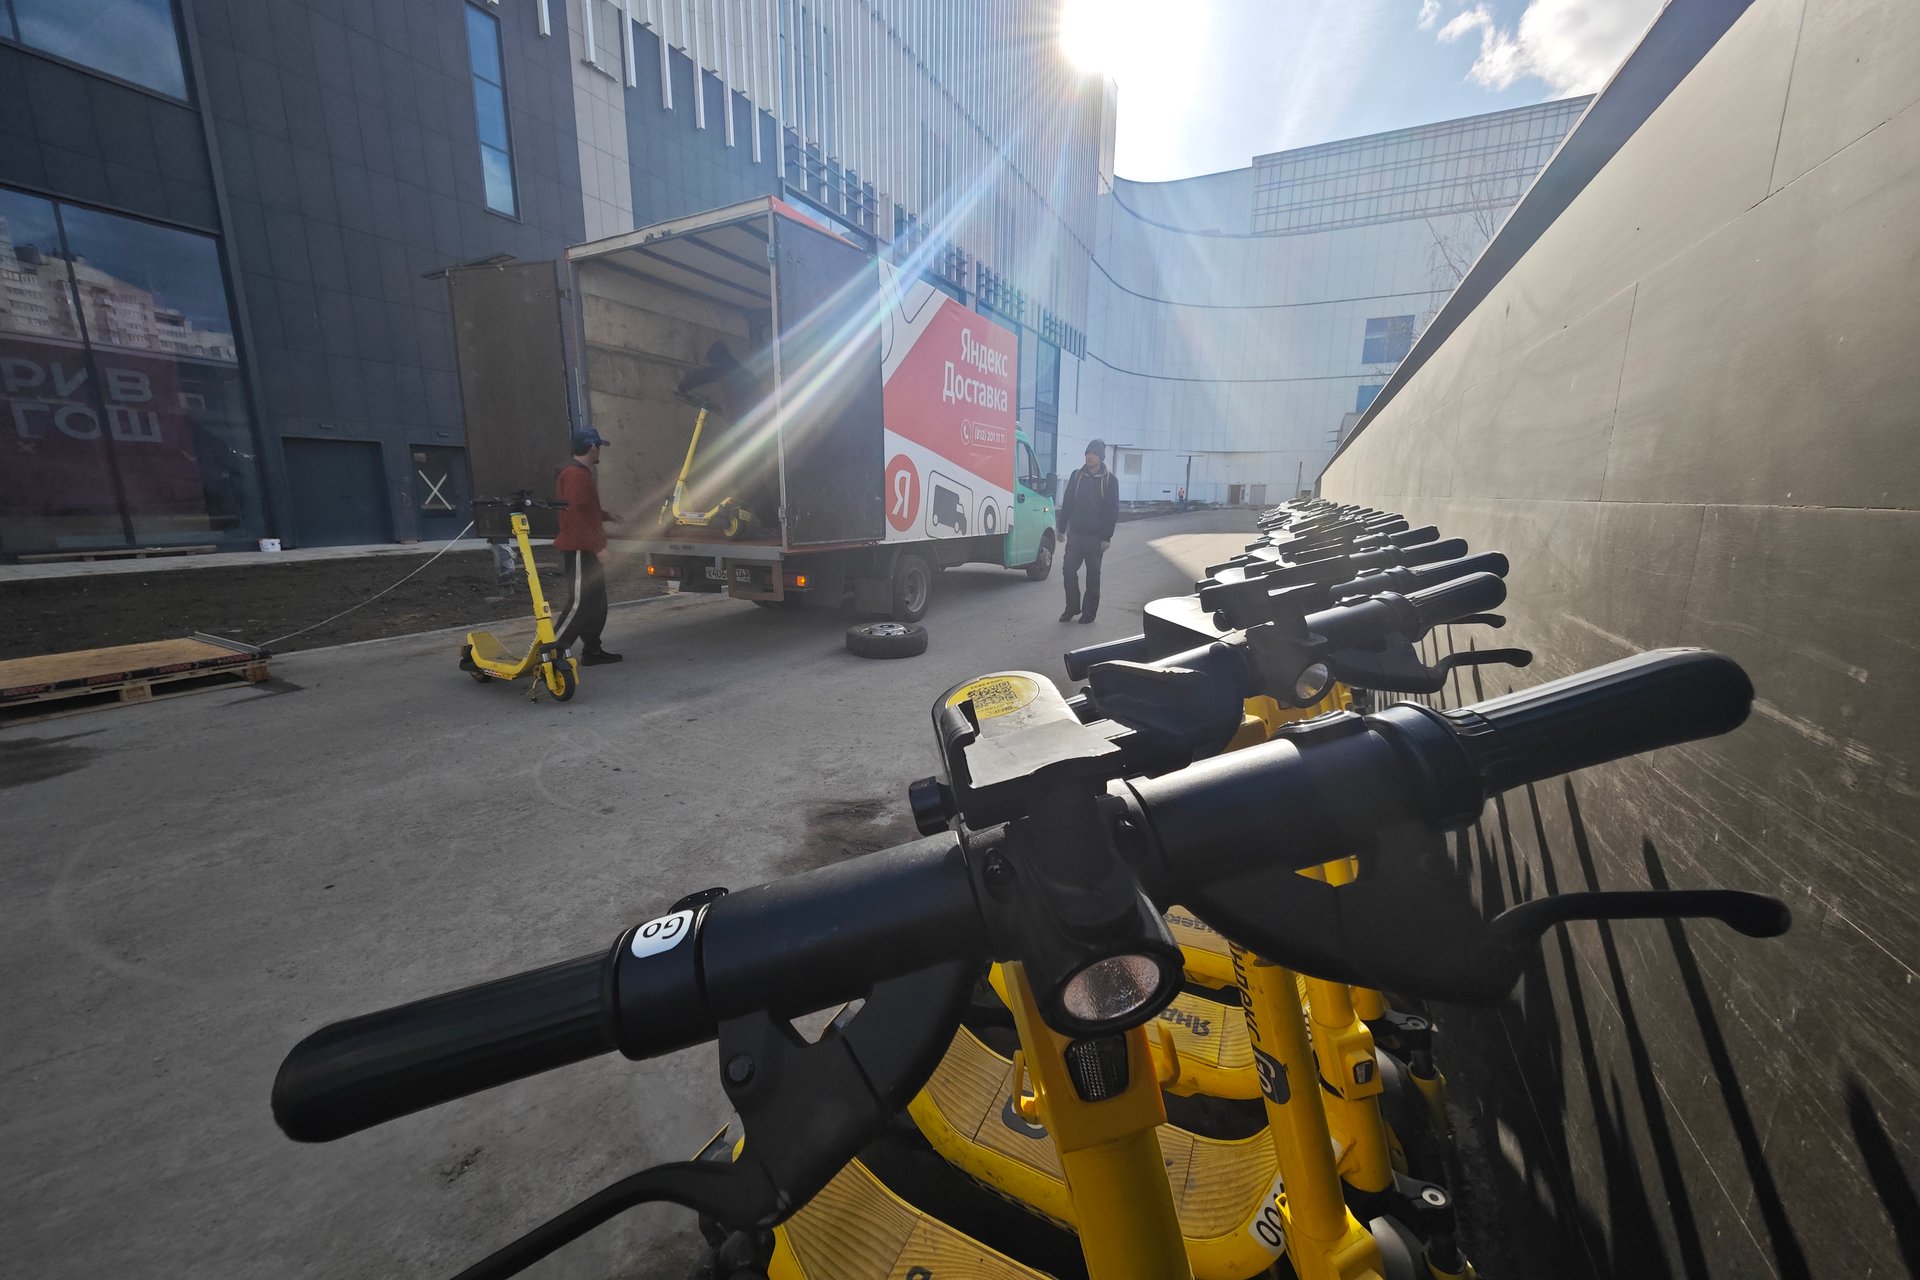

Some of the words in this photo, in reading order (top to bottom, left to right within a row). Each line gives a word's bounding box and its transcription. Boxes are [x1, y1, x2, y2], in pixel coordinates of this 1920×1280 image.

[960, 327, 1009, 379] Яндекс
[942, 360, 1008, 413] Доставка
[891, 469, 912, 519] Я
[642, 916, 685, 940] Go
[1160, 1008, 1212, 1037] Янд
